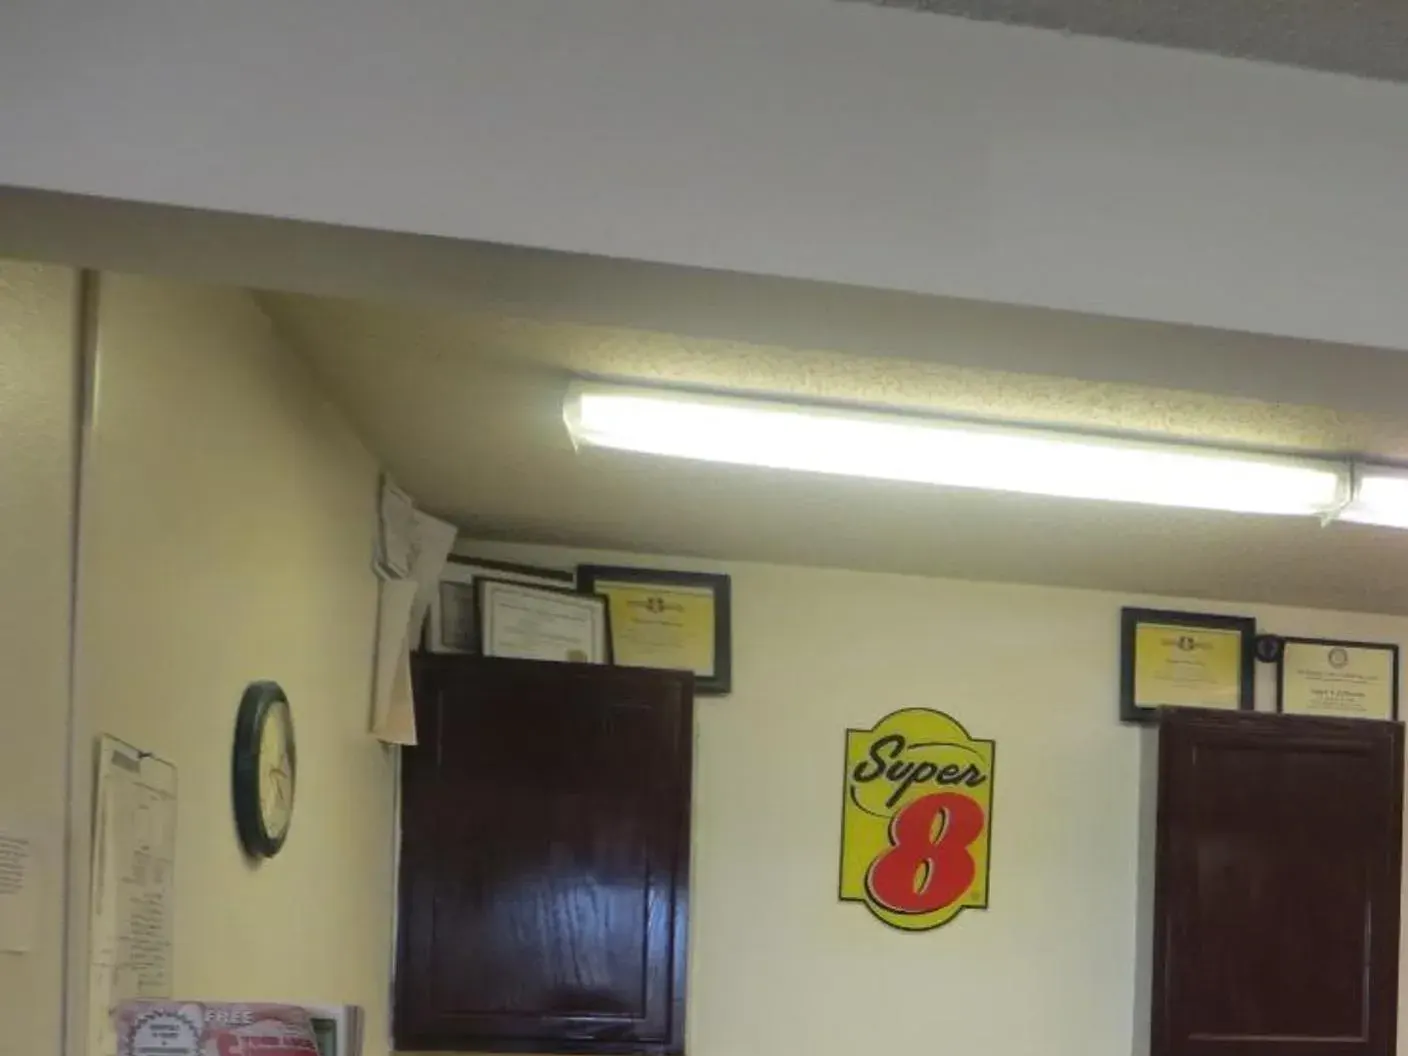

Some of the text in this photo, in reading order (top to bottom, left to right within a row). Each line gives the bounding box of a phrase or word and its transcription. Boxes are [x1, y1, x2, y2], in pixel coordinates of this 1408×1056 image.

[853, 734, 986, 810] Super
[864, 791, 985, 915] 8
[205, 1009, 254, 1025] FREE
